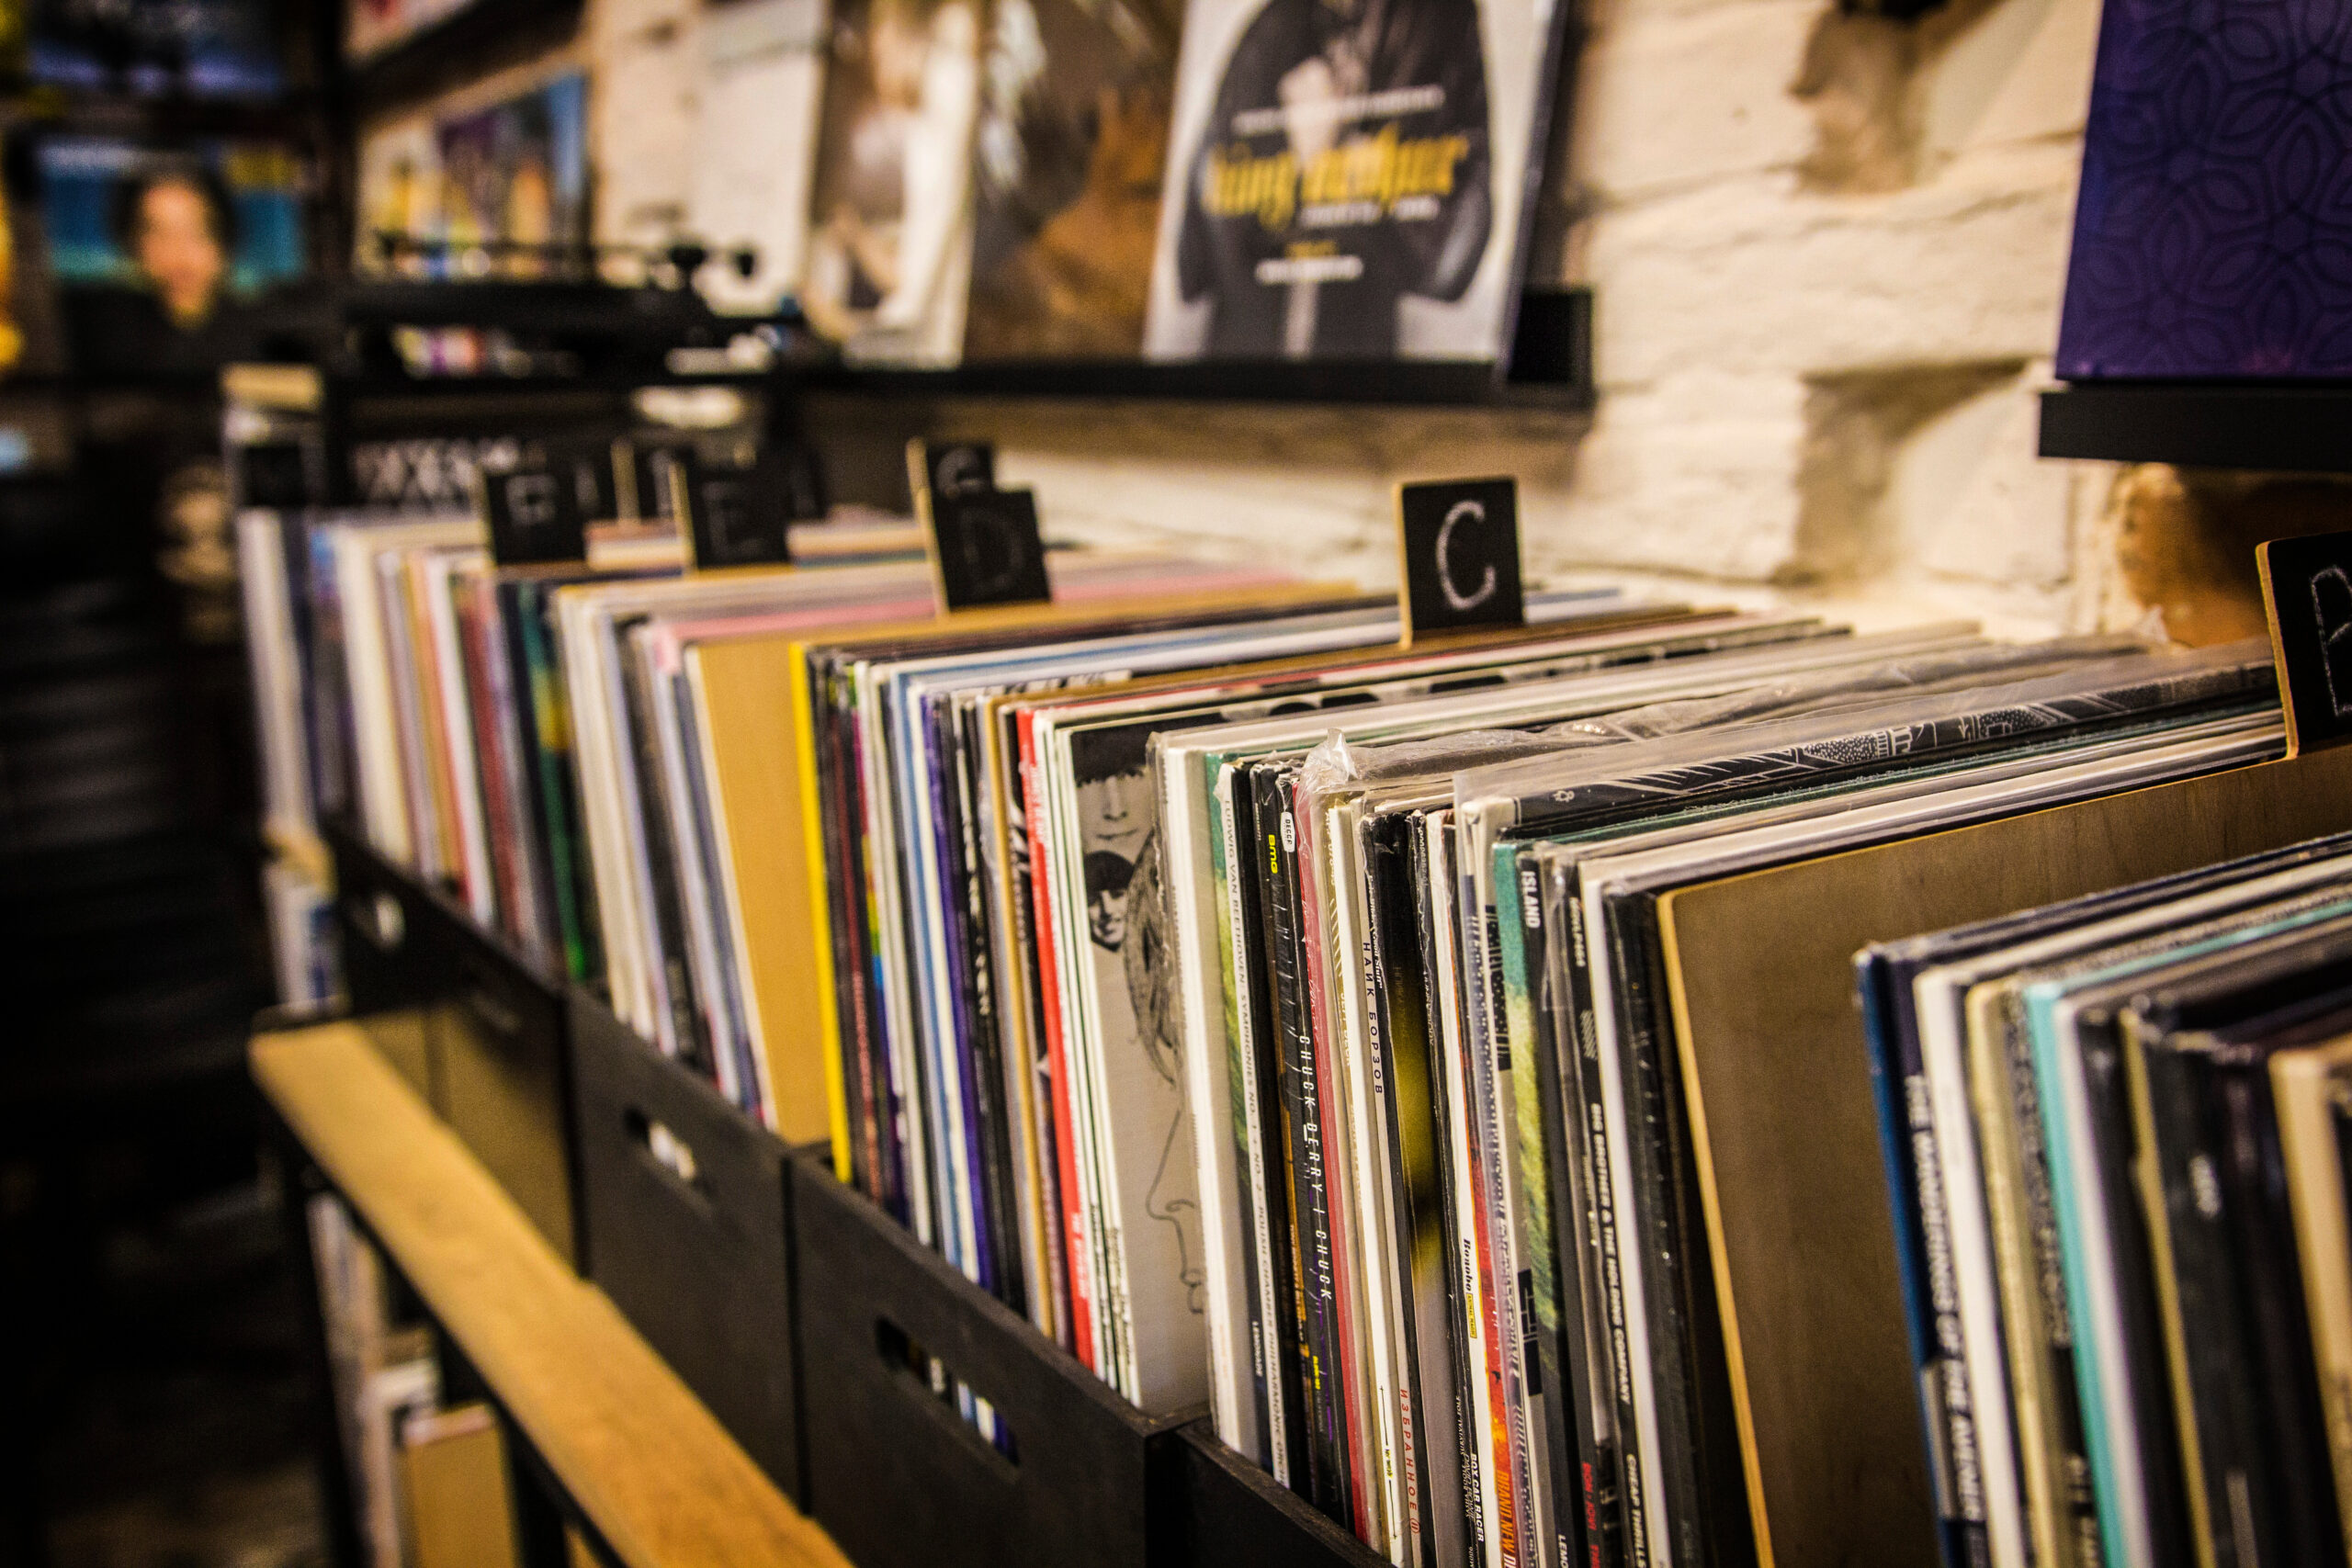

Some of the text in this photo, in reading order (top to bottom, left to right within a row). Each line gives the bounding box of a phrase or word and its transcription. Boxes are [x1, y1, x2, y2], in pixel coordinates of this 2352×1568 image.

[1435, 499, 1497, 612] C
[1225, 800, 1236, 858] LUDWIG
[1268, 834, 1278, 874] BMG
[1229, 863, 1238, 895] VAN
[1521, 871, 1541, 930] ISLAND
[1240, 994, 1254, 1087] SYMPHONIES
[1368, 1011, 1383, 1095] БОРЗОВ
[1300, 1035, 1316, 1106] CHUCK
[1590, 1102, 1603, 1132] BIG
[1306, 1122, 1323, 1192] BERRY
[1593, 1134, 1611, 1208] BROTHER
[1601, 1209, 1612, 1223] &
[1603, 1226, 1617, 1257] THE
[1316, 1229, 1331, 1300] CHUCK
[1464, 1238, 1473, 1292] Bonobo
[1606, 1258, 1623, 1326] HOLDING
[1613, 1329, 1631, 1405] COMPANY
[1399, 1389, 1418, 1511] ИЗБРАННОЕ
[1472, 1478, 1480, 1503] CAR
[1497, 1470, 1512, 1518] BRAND
[1626, 1453, 1640, 1507] CHEAP
[1473, 1504, 1484, 1542] RACER
[1500, 1519, 1515, 1553] NEW
